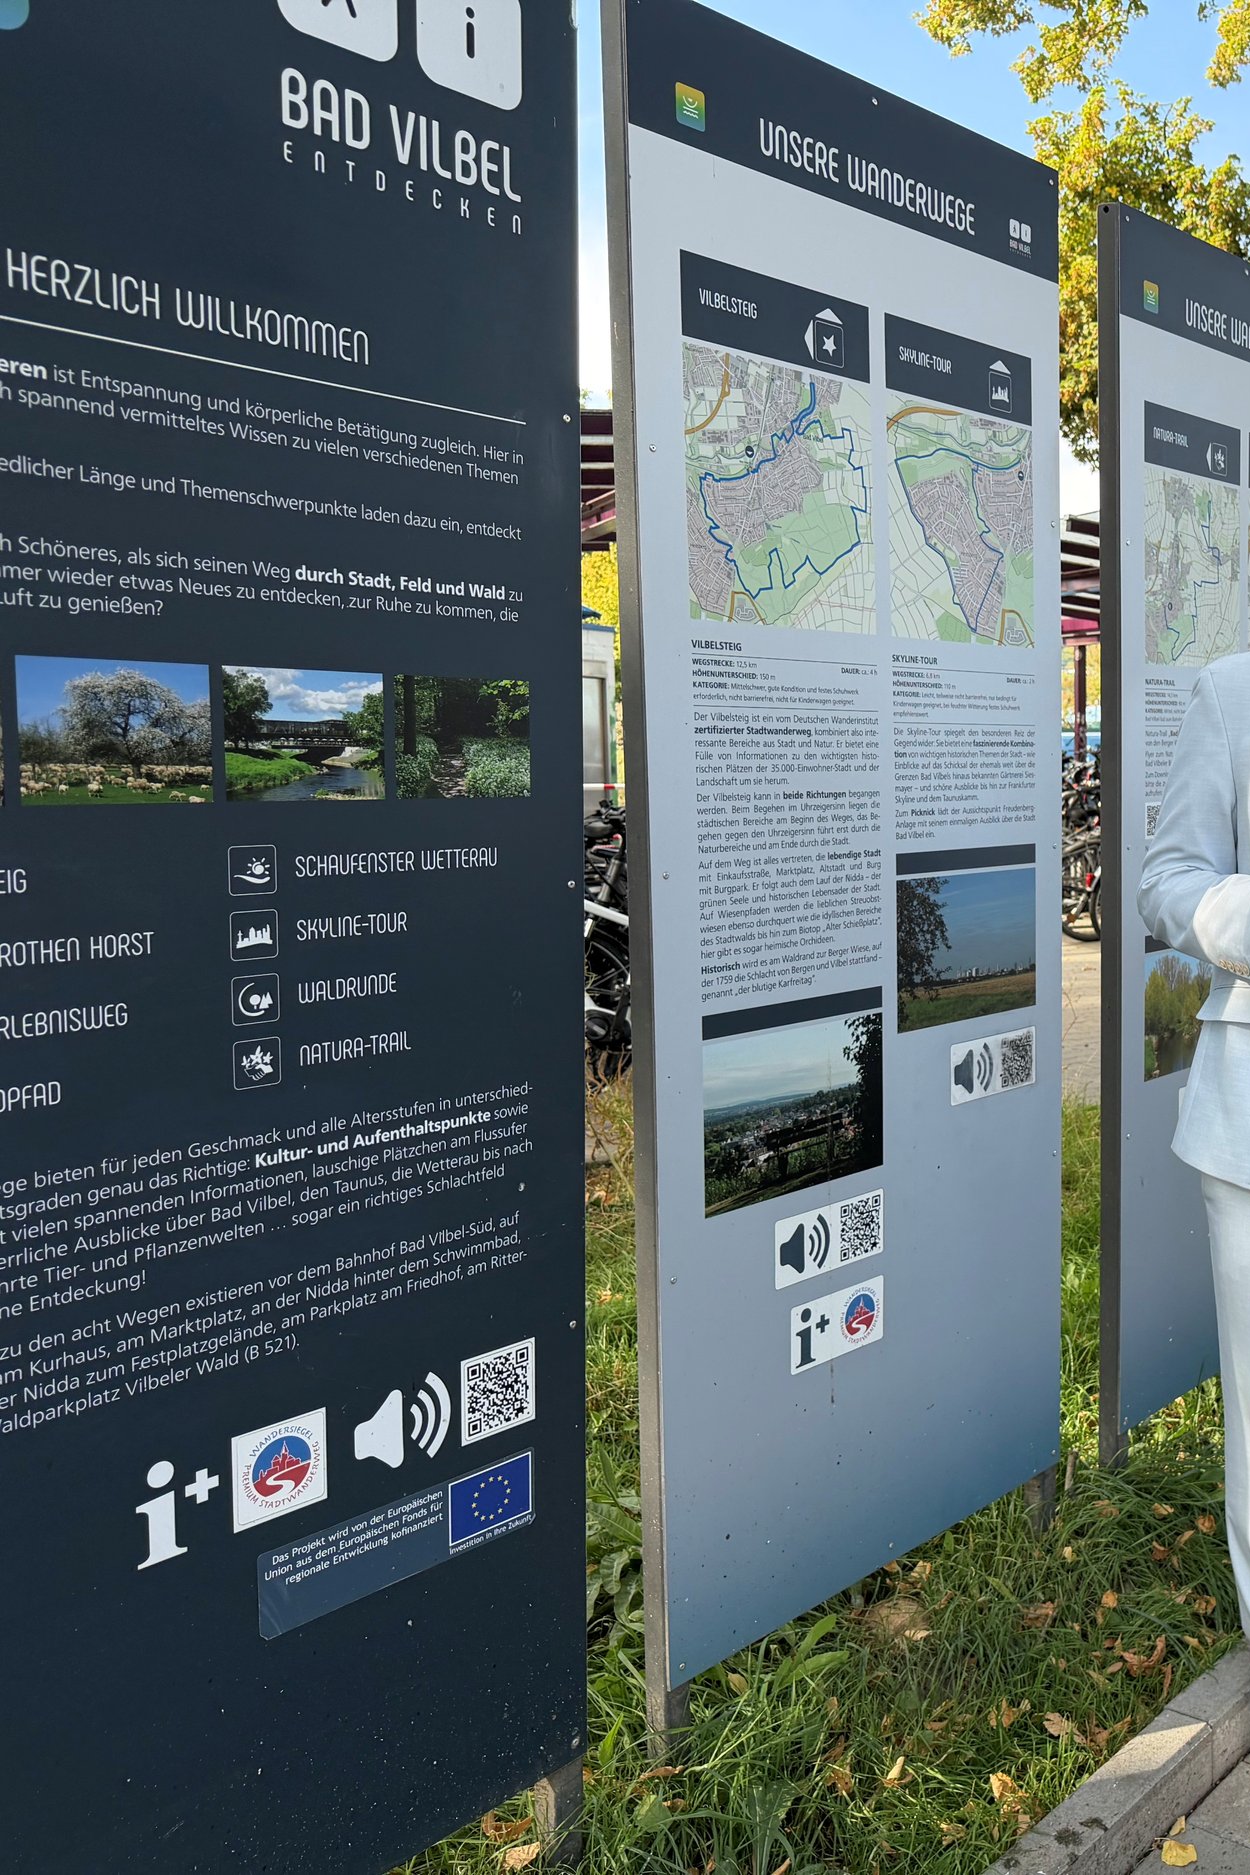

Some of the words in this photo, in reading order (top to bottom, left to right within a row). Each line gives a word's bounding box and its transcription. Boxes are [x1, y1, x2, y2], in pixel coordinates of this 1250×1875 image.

[280, 67, 370, 149] BAD
[389, 104, 521, 202] VILBEL
[283, 140, 521, 234] ENTDECKEN
[759, 117, 839, 183] UNSERE
[847, 153, 975, 235] WANDERWEGE
[6, 247, 160, 319] HERZLICH
[175, 287, 369, 365] WILLKOMMEN
[698, 287, 757, 319] VILBELSTEIG
[1185, 298, 1227, 340] UNSERE
[898, 345, 951, 374] SKYLINE-TOUR
[18, 388, 114, 417] spannend
[119, 406, 225, 435] vermitteltes
[228, 421, 287, 446] Wissen
[292, 435, 310, 449] zu
[314, 437, 358, 458] vielen
[362, 448, 462, 475] verschiedenen
[465, 462, 518, 484] Themen
[53, 368, 75, 384] ist
[81, 369, 201, 411] Entspannung
[207, 396, 240, 414] und
[245, 399, 333, 430] körperliche
[337, 417, 417, 449] Betätigung
[421, 436, 479, 457] zugleich.
[483, 444, 509, 462] Hier
[512, 449, 523, 464] in
[1153, 426, 1188, 447] NATURA-TRAIL
[79, 464, 136, 491] Länge
[141, 476, 175, 493] und
[179, 478, 357, 518] Themenschwerpunkte
[361, 503, 400, 523] laden
[403, 510, 436, 528] dazu
[440, 516, 463, 534] ein,
[466, 522, 521, 540] entdeckt
[18, 535, 121, 565] Schöneres,
[127, 547, 151, 565] als
[155, 550, 188, 569] sich
[193, 556, 247, 574] seinen
[252, 560, 290, 583] Weg
[294, 564, 343, 584] durch
[348, 570, 395, 591] Stadt,
[399, 575, 431, 592] Feld
[435, 581, 464, 596] und
[468, 583, 505, 600] Wald
[508, 590, 522, 601] zu
[690, 639, 742, 651] VILBELSTEIG
[691, 657, 735, 667] WEGSTRECKE:
[736, 660, 747, 668] 12,5
[891, 653, 937, 665] SKYLINE-TOUR
[692, 668, 758, 679] HÖHENUNTERSCHIED:
[759, 672, 769, 680] 150
[693, 711, 708, 721] Der
[709, 712, 749, 724] Vilbelsteig
[751, 713, 760, 722] ist
[761, 713, 773, 722] ein
[775, 715, 791, 723] vom
[792, 714, 829, 724] Deutschen
[830, 715, 879, 725] Wanderinstitut
[694, 724, 745, 734] zertifizierter
[814, 726, 850, 736] kombiniert
[850, 727, 864, 736] also
[295, 850, 414, 877] SCHAUFENSTER
[421, 847, 497, 870] WETTERAU
[90, 931, 154, 959] HORST
[296, 911, 407, 941] SKYLINE-TOUR
[298, 972, 397, 1003] WALDRUNDE
[299, 1030, 411, 1066] NATURA-TRAIL
[0, 1178, 27, 1198] ge
[34, 1165, 94, 1188] bieten
[100, 1157, 127, 1175] für
[131, 1148, 182, 1174] jeden
[187, 1127, 281, 1158] Geschmack
[286, 1119, 315, 1139] und
[320, 1116, 346, 1133] alle
[350, 1101, 434, 1127] Altersstufen
[439, 1099, 451, 1110] in
[455, 1082, 533, 1107] unterschied-
[87, 1179, 143, 1206] genau
[148, 1171, 178, 1189] das
[183, 1159, 250, 1182] Richtige:
[255, 1147, 313, 1168] Kultur-
[317, 1135, 348, 1155] und
[352, 1110, 491, 1148] Aufenthaltspunkte
[493, 1103, 528, 1119] sowie
[249, 1425, 314, 1458] WANDERSIEGEL
[241, 1464, 259, 1505] PREMIUM
[258, 1441, 321, 1509] STADTWANDERWEG
[264, 1563, 292, 1580] Union
[295, 1555, 312, 1568] aus
[315, 1545, 336, 1559] dem
[337, 1519, 399, 1552] Europäischen
[404, 1508, 427, 1528] Fonds
[430, 1500, 443, 1512] für
[272, 1552, 289, 1565] Das
[291, 1537, 326, 1557] Projekt
[327, 1526, 349, 1541] wird
[350, 1520, 367, 1532] von
[368, 1513, 385, 1531] der
[387, 1490, 443, 1518] Europäischen
[449, 1535, 484, 1555] Investition
[493, 1525, 507, 1535] Ihre
[508, 1513, 532, 1529] Zukunft
[285, 1560, 330, 1585] regionale
[333, 1535, 388, 1564] Entwicklung
[390, 1513, 444, 1540] kofinanziert
